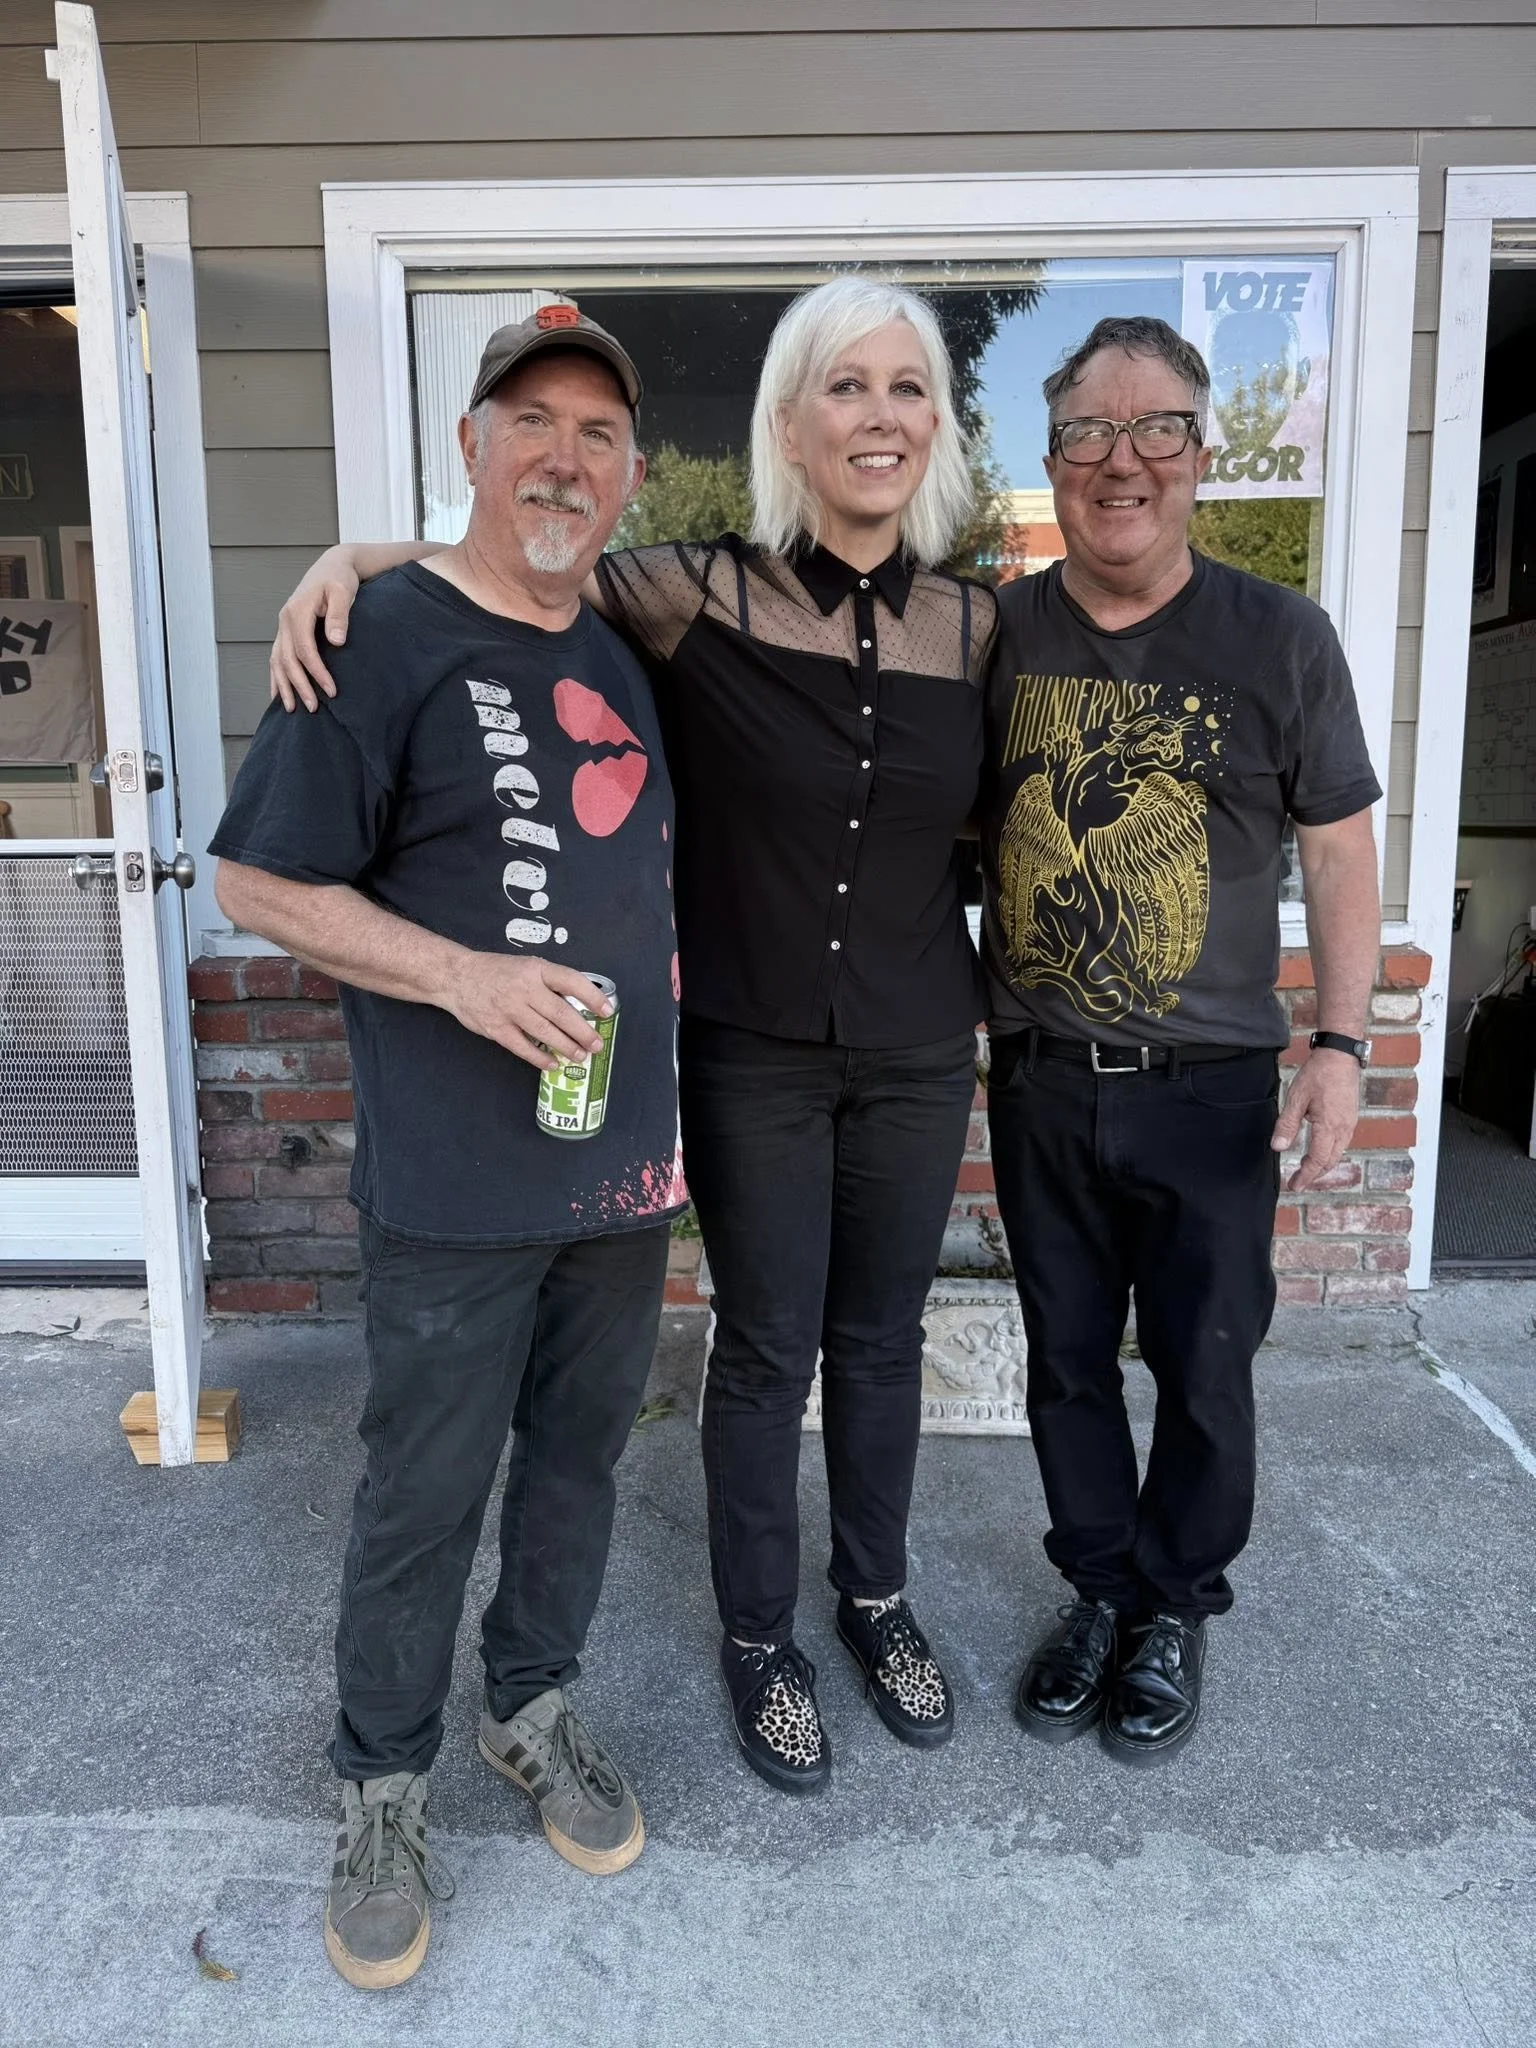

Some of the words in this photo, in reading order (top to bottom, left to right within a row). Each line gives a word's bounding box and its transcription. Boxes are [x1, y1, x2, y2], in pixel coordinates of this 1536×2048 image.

[1202, 271, 1312, 312] VOTE
[1002, 674, 1162, 768] THUNDERPUSSY
[465, 679, 568, 948] melvi
[556, 1115, 579, 1129] IPA
